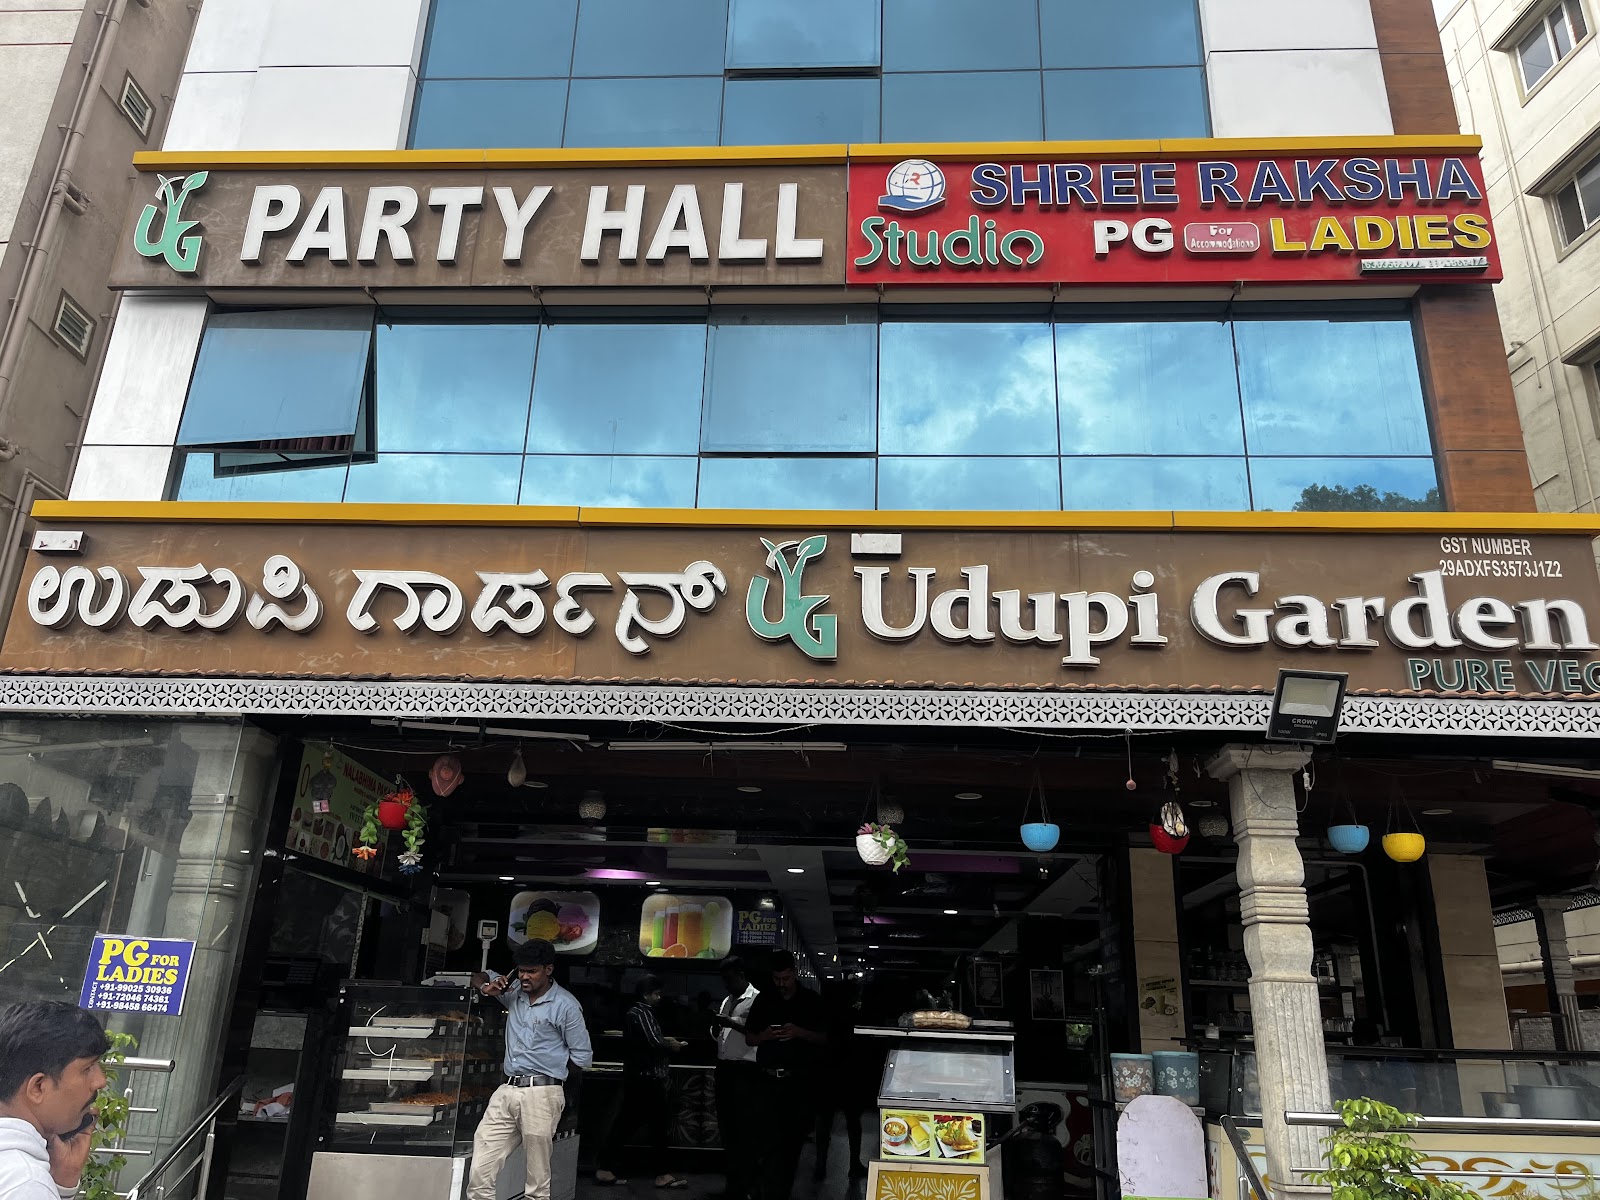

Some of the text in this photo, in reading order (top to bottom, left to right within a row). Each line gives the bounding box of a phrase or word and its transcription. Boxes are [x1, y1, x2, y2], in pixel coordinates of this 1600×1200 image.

[969, 157, 1482, 207] SHREE RAKSHA
[240, 182, 824, 261] PARTY HALL
[854, 214, 1045, 266] Studio
[1093, 213, 1492, 254] PG LADIES
[1440, 536, 1533, 556] GST NUMBER
[1439, 559, 1563, 578] 29ADXFS3573J1Z2
[27, 554, 728, 655] ಉಡುಪಿ ಗಾರ್ಡನ್
[853, 564, 1600, 667] Udupi Garden
[1407, 658, 1516, 692] PURE
[1291, 717, 1319, 726] CROWN
[738, 910, 762, 923] PG
[738, 923, 777, 931] LADIES
[98, 939, 180, 966] PG FOR
[96, 965, 179, 985] LADIES
[87, 981, 98, 1009] CONTACT
[97, 992, 142, 1002] +91-72046
[100, 983, 172, 994] +91-99025 30936
[95, 1001, 168, 1013] +91-98458 66474
